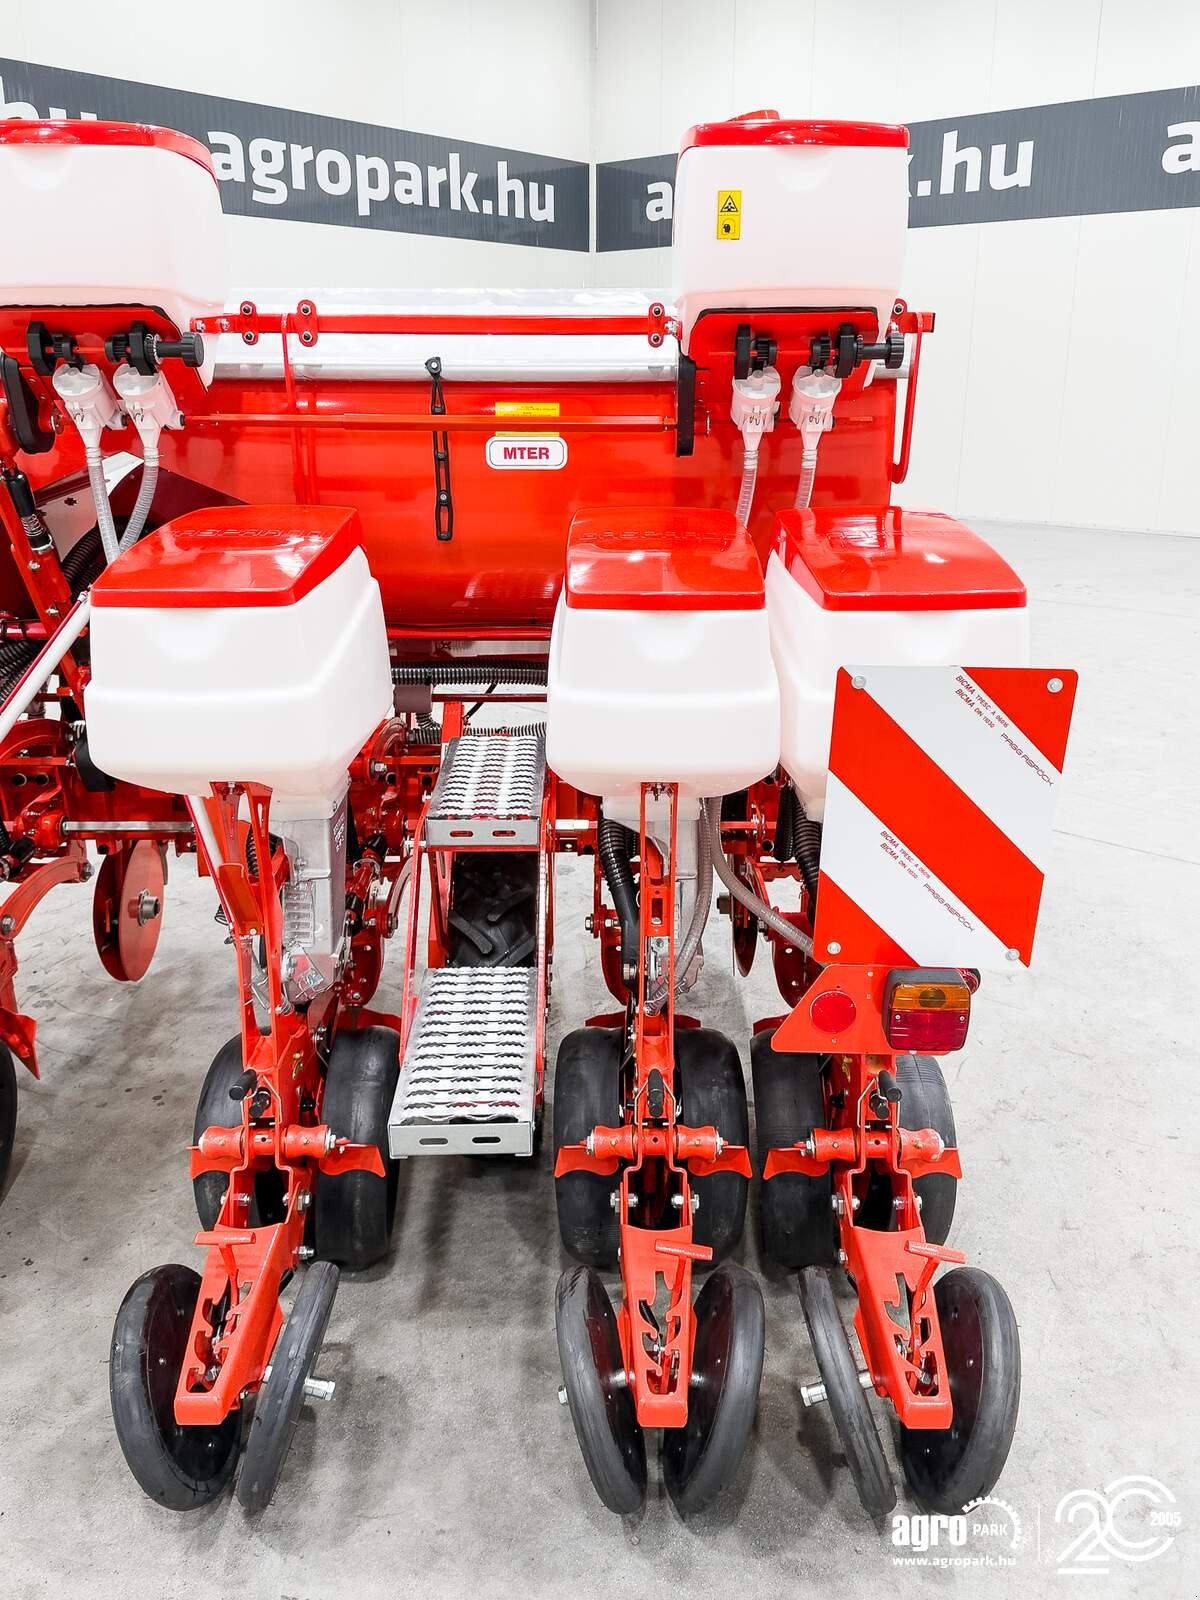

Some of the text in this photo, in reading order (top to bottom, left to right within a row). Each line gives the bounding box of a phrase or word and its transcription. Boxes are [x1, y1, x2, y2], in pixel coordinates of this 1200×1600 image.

[207, 131, 555, 223] agropark.hu
[503, 447, 550, 460] MTER
[955, 675, 976, 695] BICMA
[955, 688, 975, 708] BICMA
[880, 830, 899, 849] BICMA
[880, 842, 899, 861] BICMA
